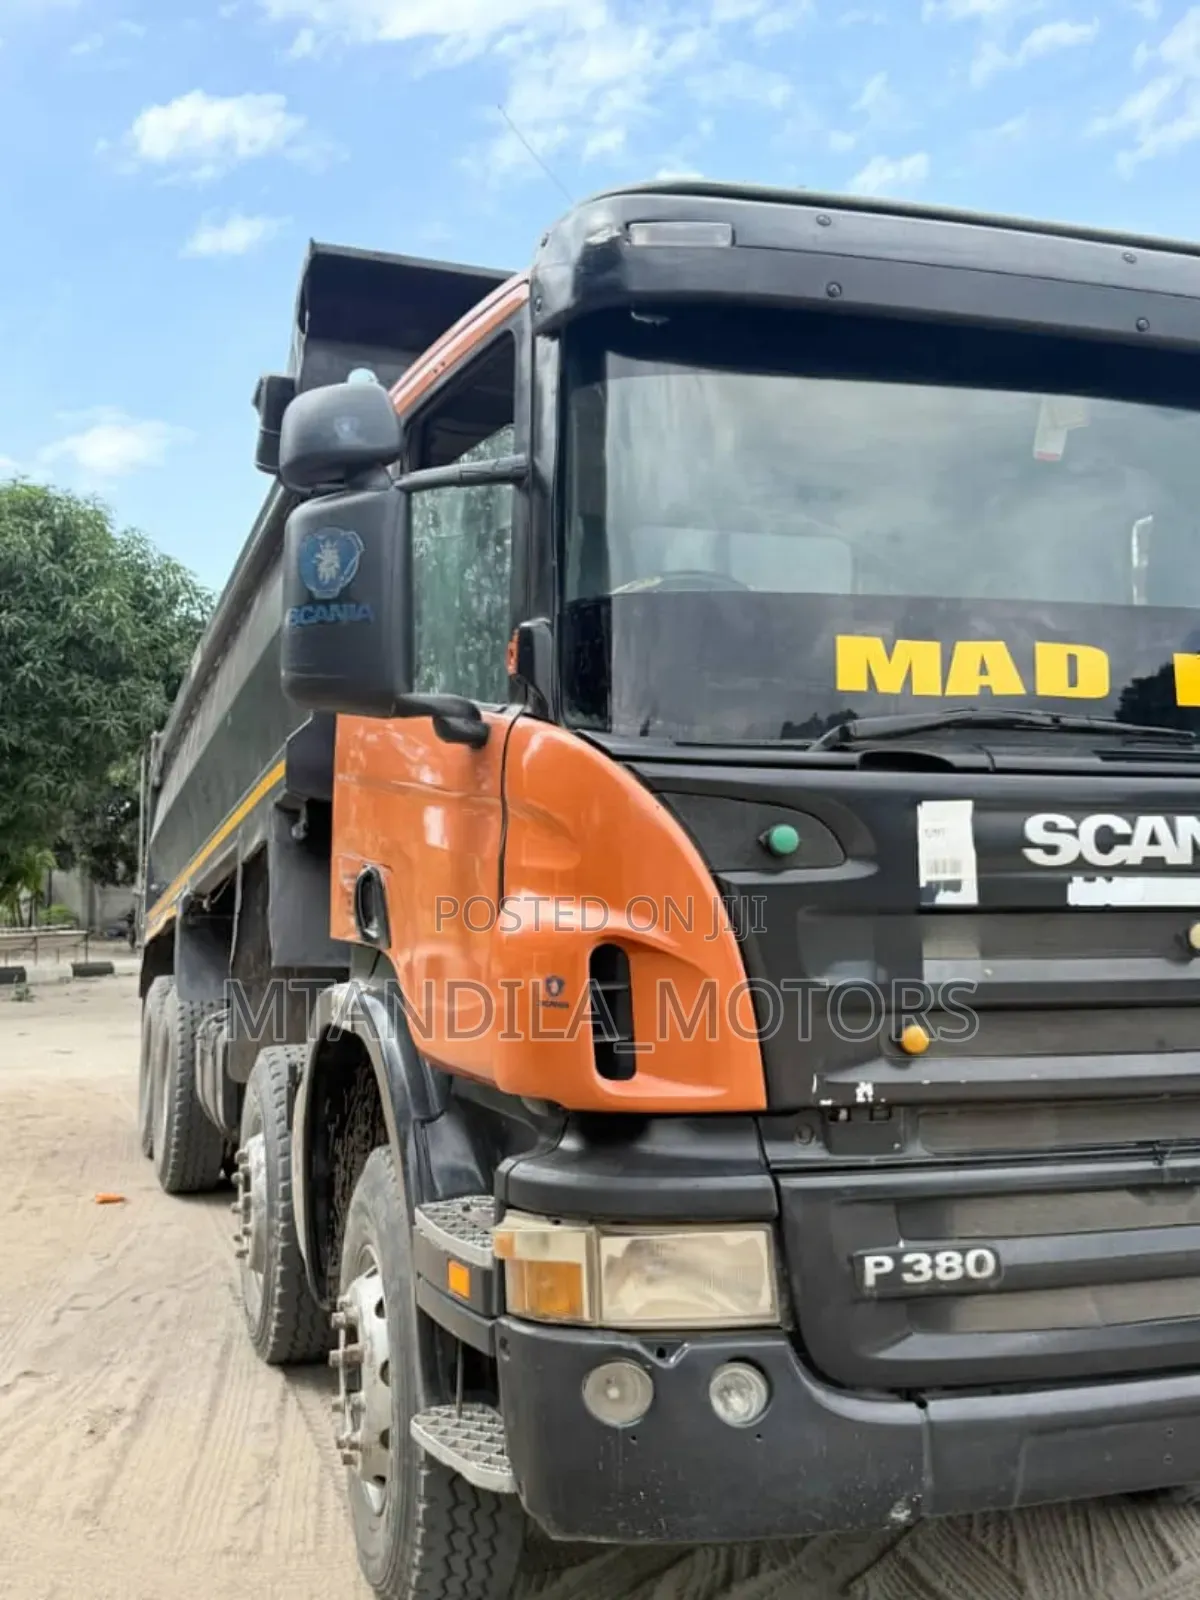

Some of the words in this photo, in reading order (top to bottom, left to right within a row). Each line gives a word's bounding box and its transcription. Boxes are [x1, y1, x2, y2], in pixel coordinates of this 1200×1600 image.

[836, 635, 1110, 699] MAD
[864, 1255, 894, 1287] P
[901, 1248, 996, 1283] 380
